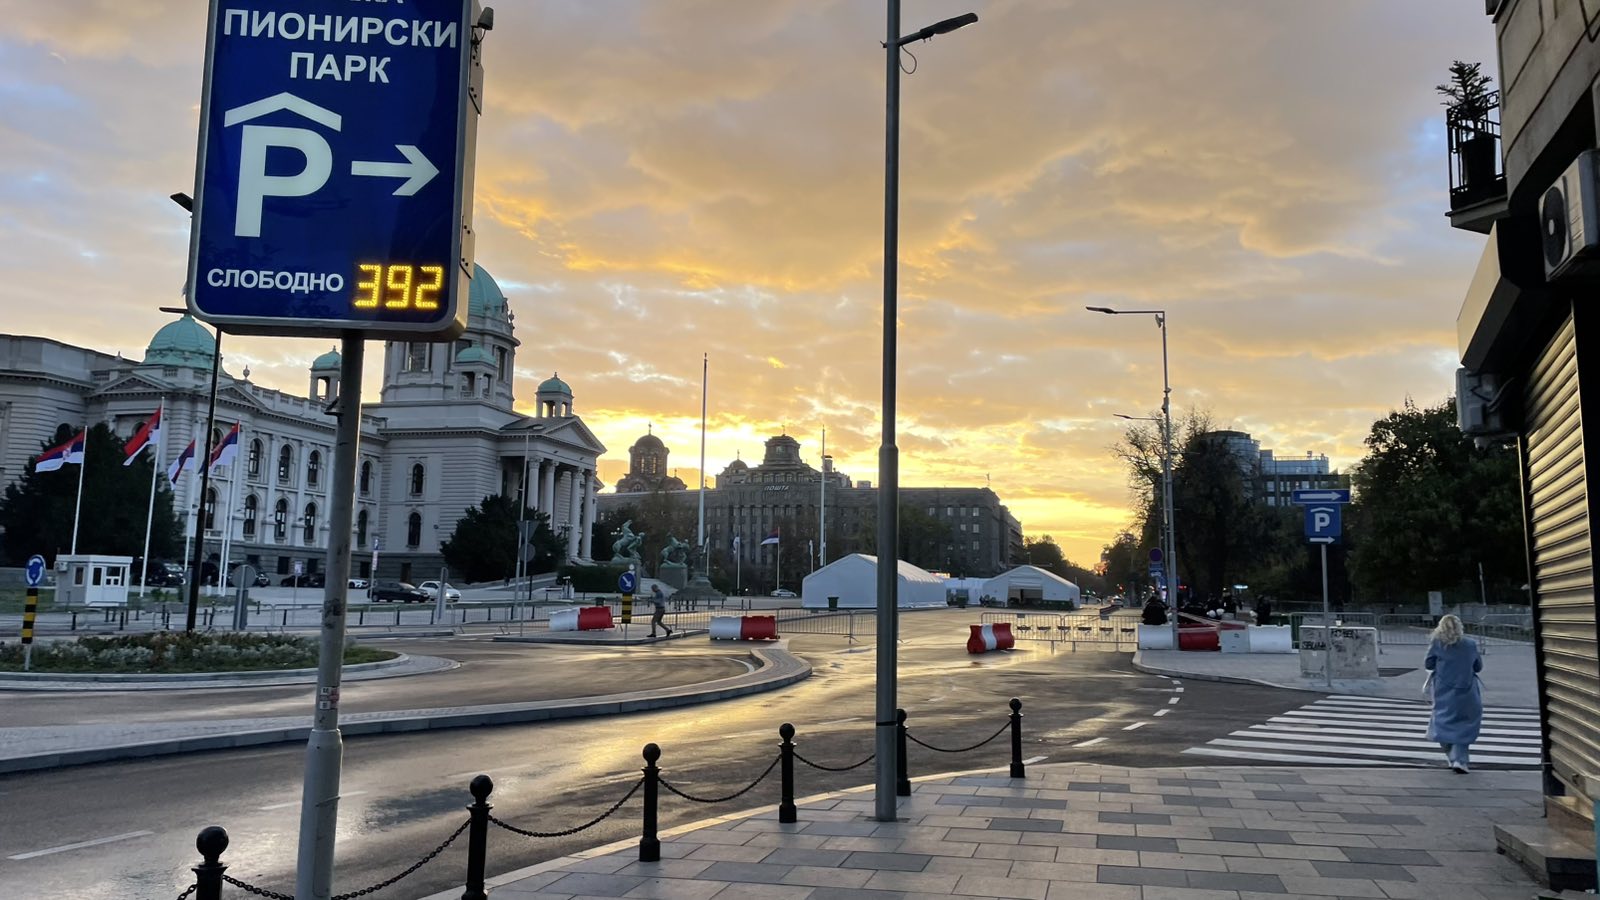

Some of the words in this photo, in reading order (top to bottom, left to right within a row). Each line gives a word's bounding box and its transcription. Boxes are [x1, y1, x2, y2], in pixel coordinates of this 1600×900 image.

[223, 9, 457, 48] ПИОНИРСКИ
[290, 52, 391, 83] ПАРК
[234, 125, 333, 237] P
[207, 268, 344, 293] СЛОБОДНО
[355, 264, 444, 309] 392
[1314, 513, 1330, 532] P
